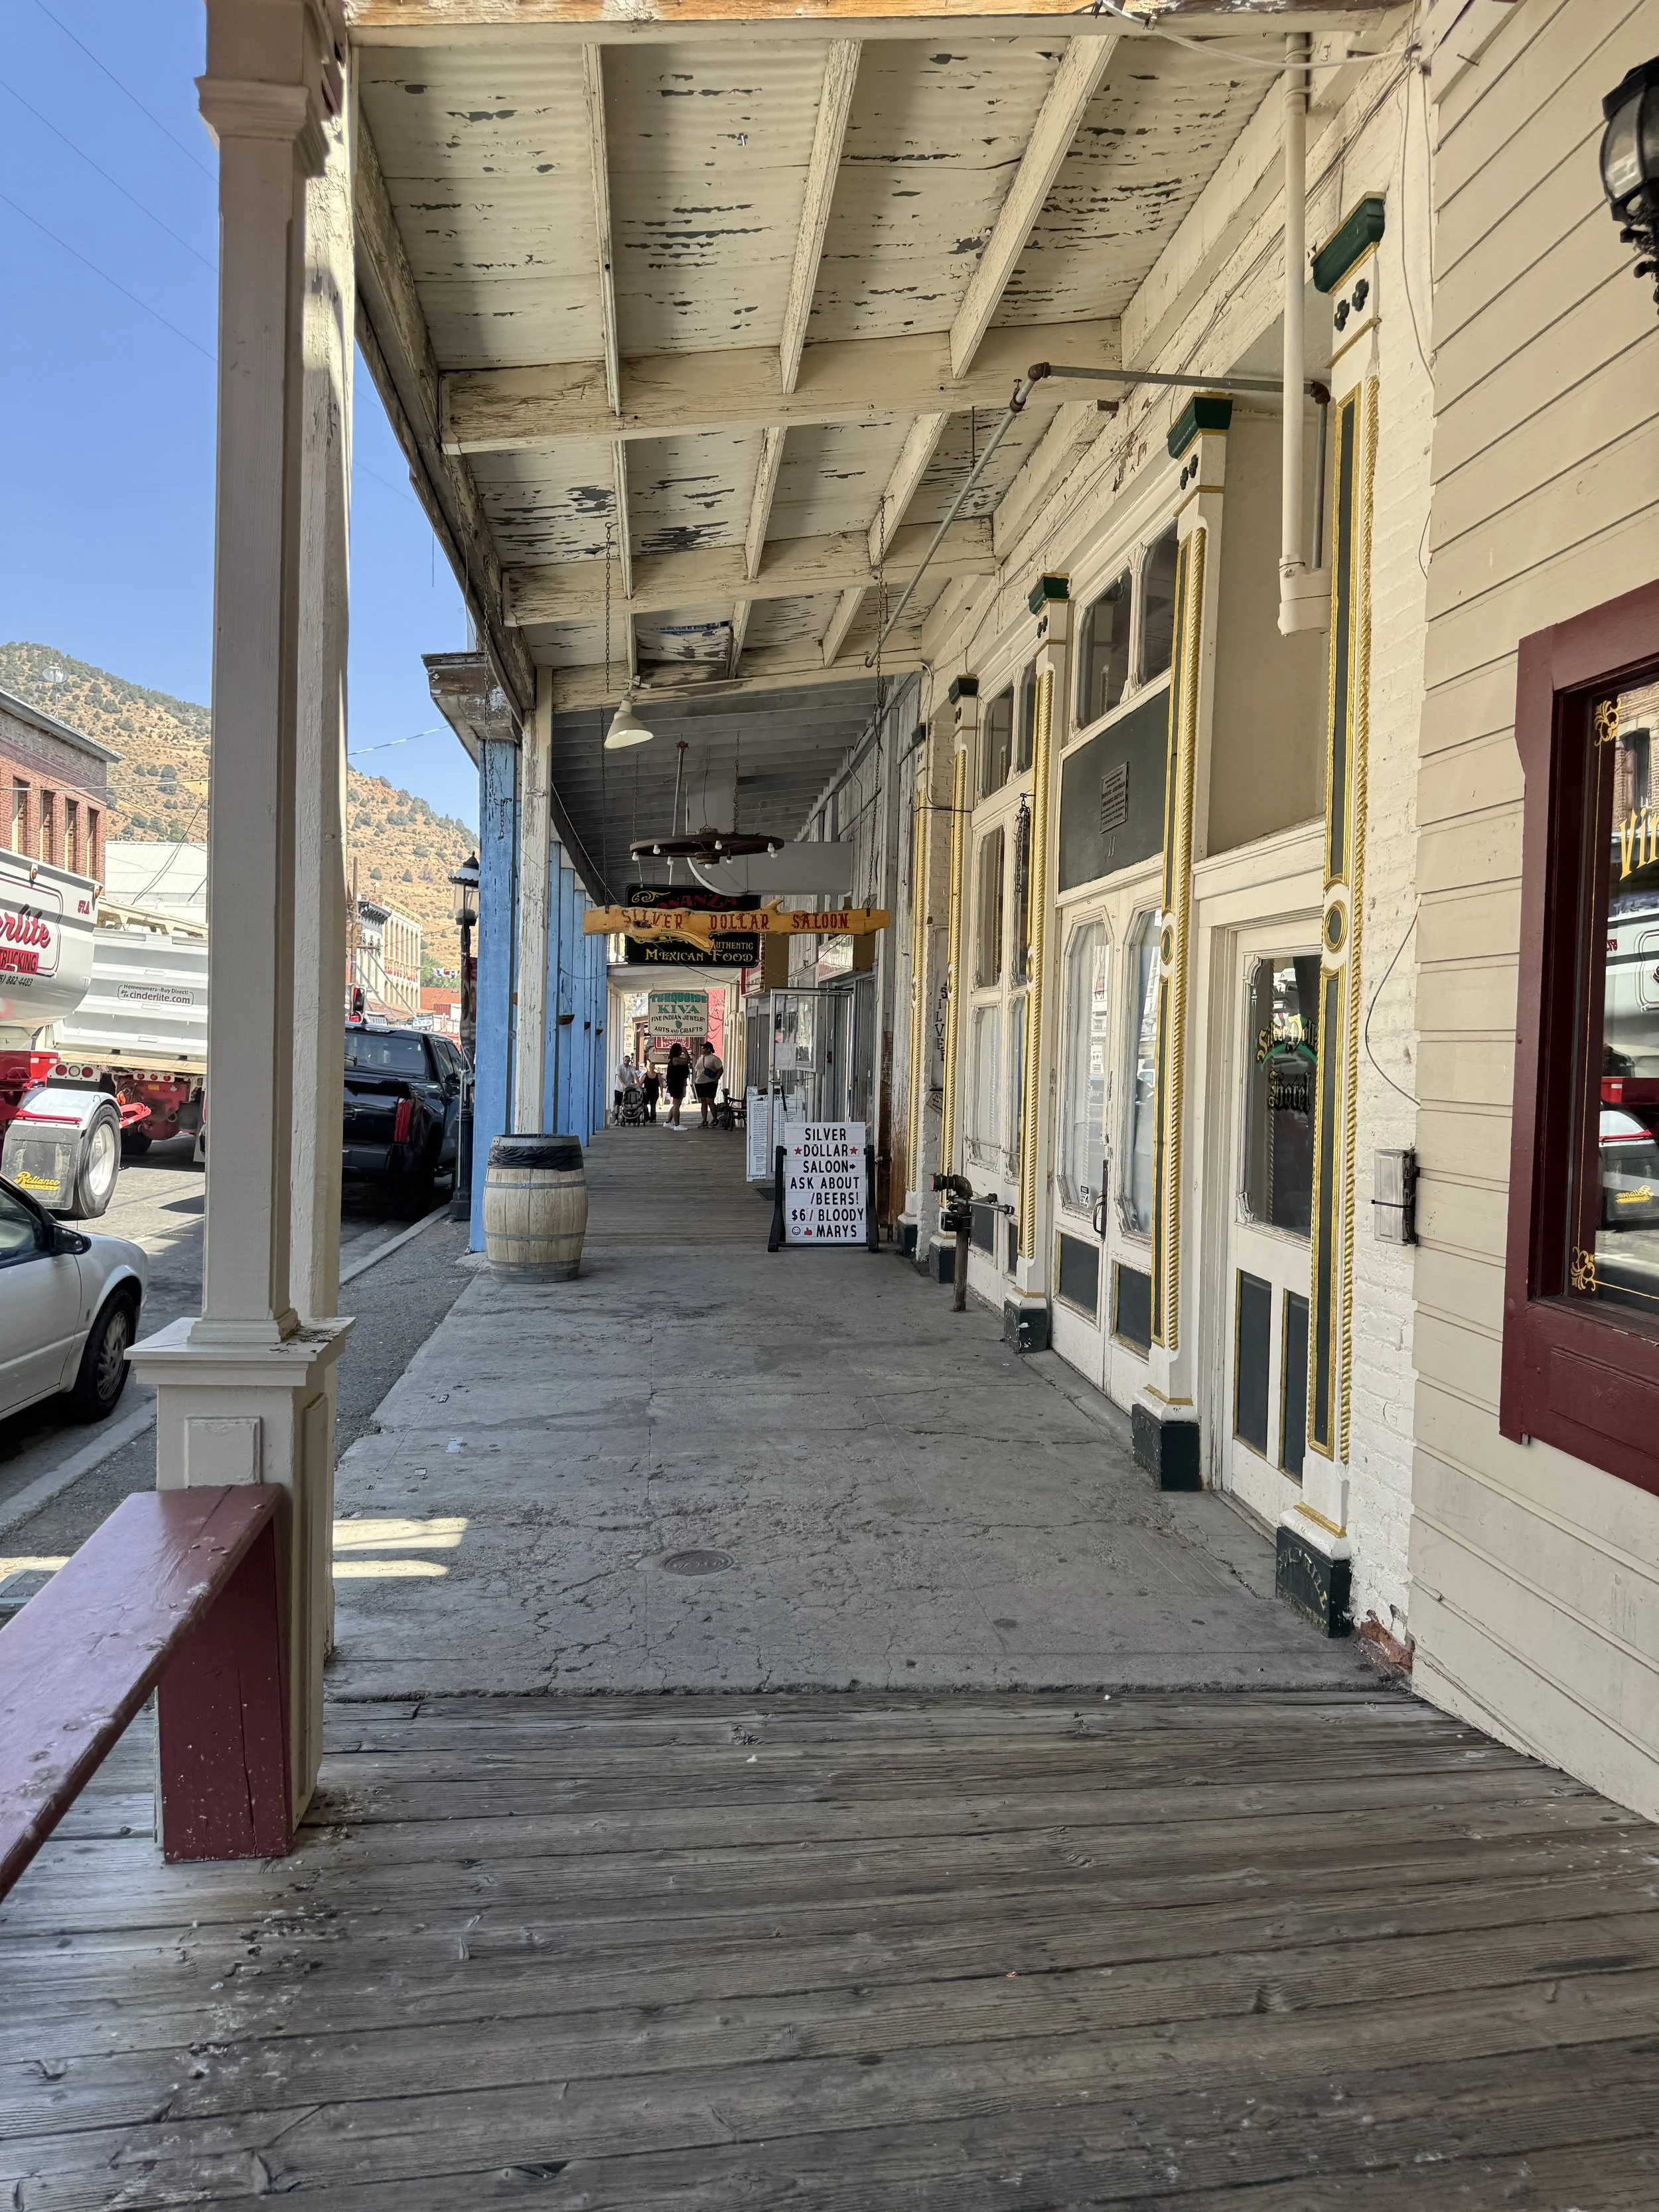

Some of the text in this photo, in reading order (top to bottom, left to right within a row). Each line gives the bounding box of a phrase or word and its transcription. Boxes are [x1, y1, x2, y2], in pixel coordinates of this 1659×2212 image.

[0, 903, 51, 948] rlite
[620, 909, 850, 930] SILVER DOLLAR SALOON
[712, 939, 754, 950] AUTHENTIC
[645, 948, 754, 962] MEXICAN FOOD
[129, 991, 190, 1004] cinderlite.com
[650, 992, 707, 1004] TURQUOISE
[658, 1005, 700, 1014] KIVA
[804, 1128, 847, 1141] SILVER
[804, 1143, 848, 1157] DOLLAR
[803, 1160, 849, 1173] SALOON
[13, 1171, 60, 1186] Reliance
[790, 1176, 860, 1189] ASK ABOUT
[818, 1208, 864, 1221] BLOODY
[816, 1224, 857, 1238] MARYS
